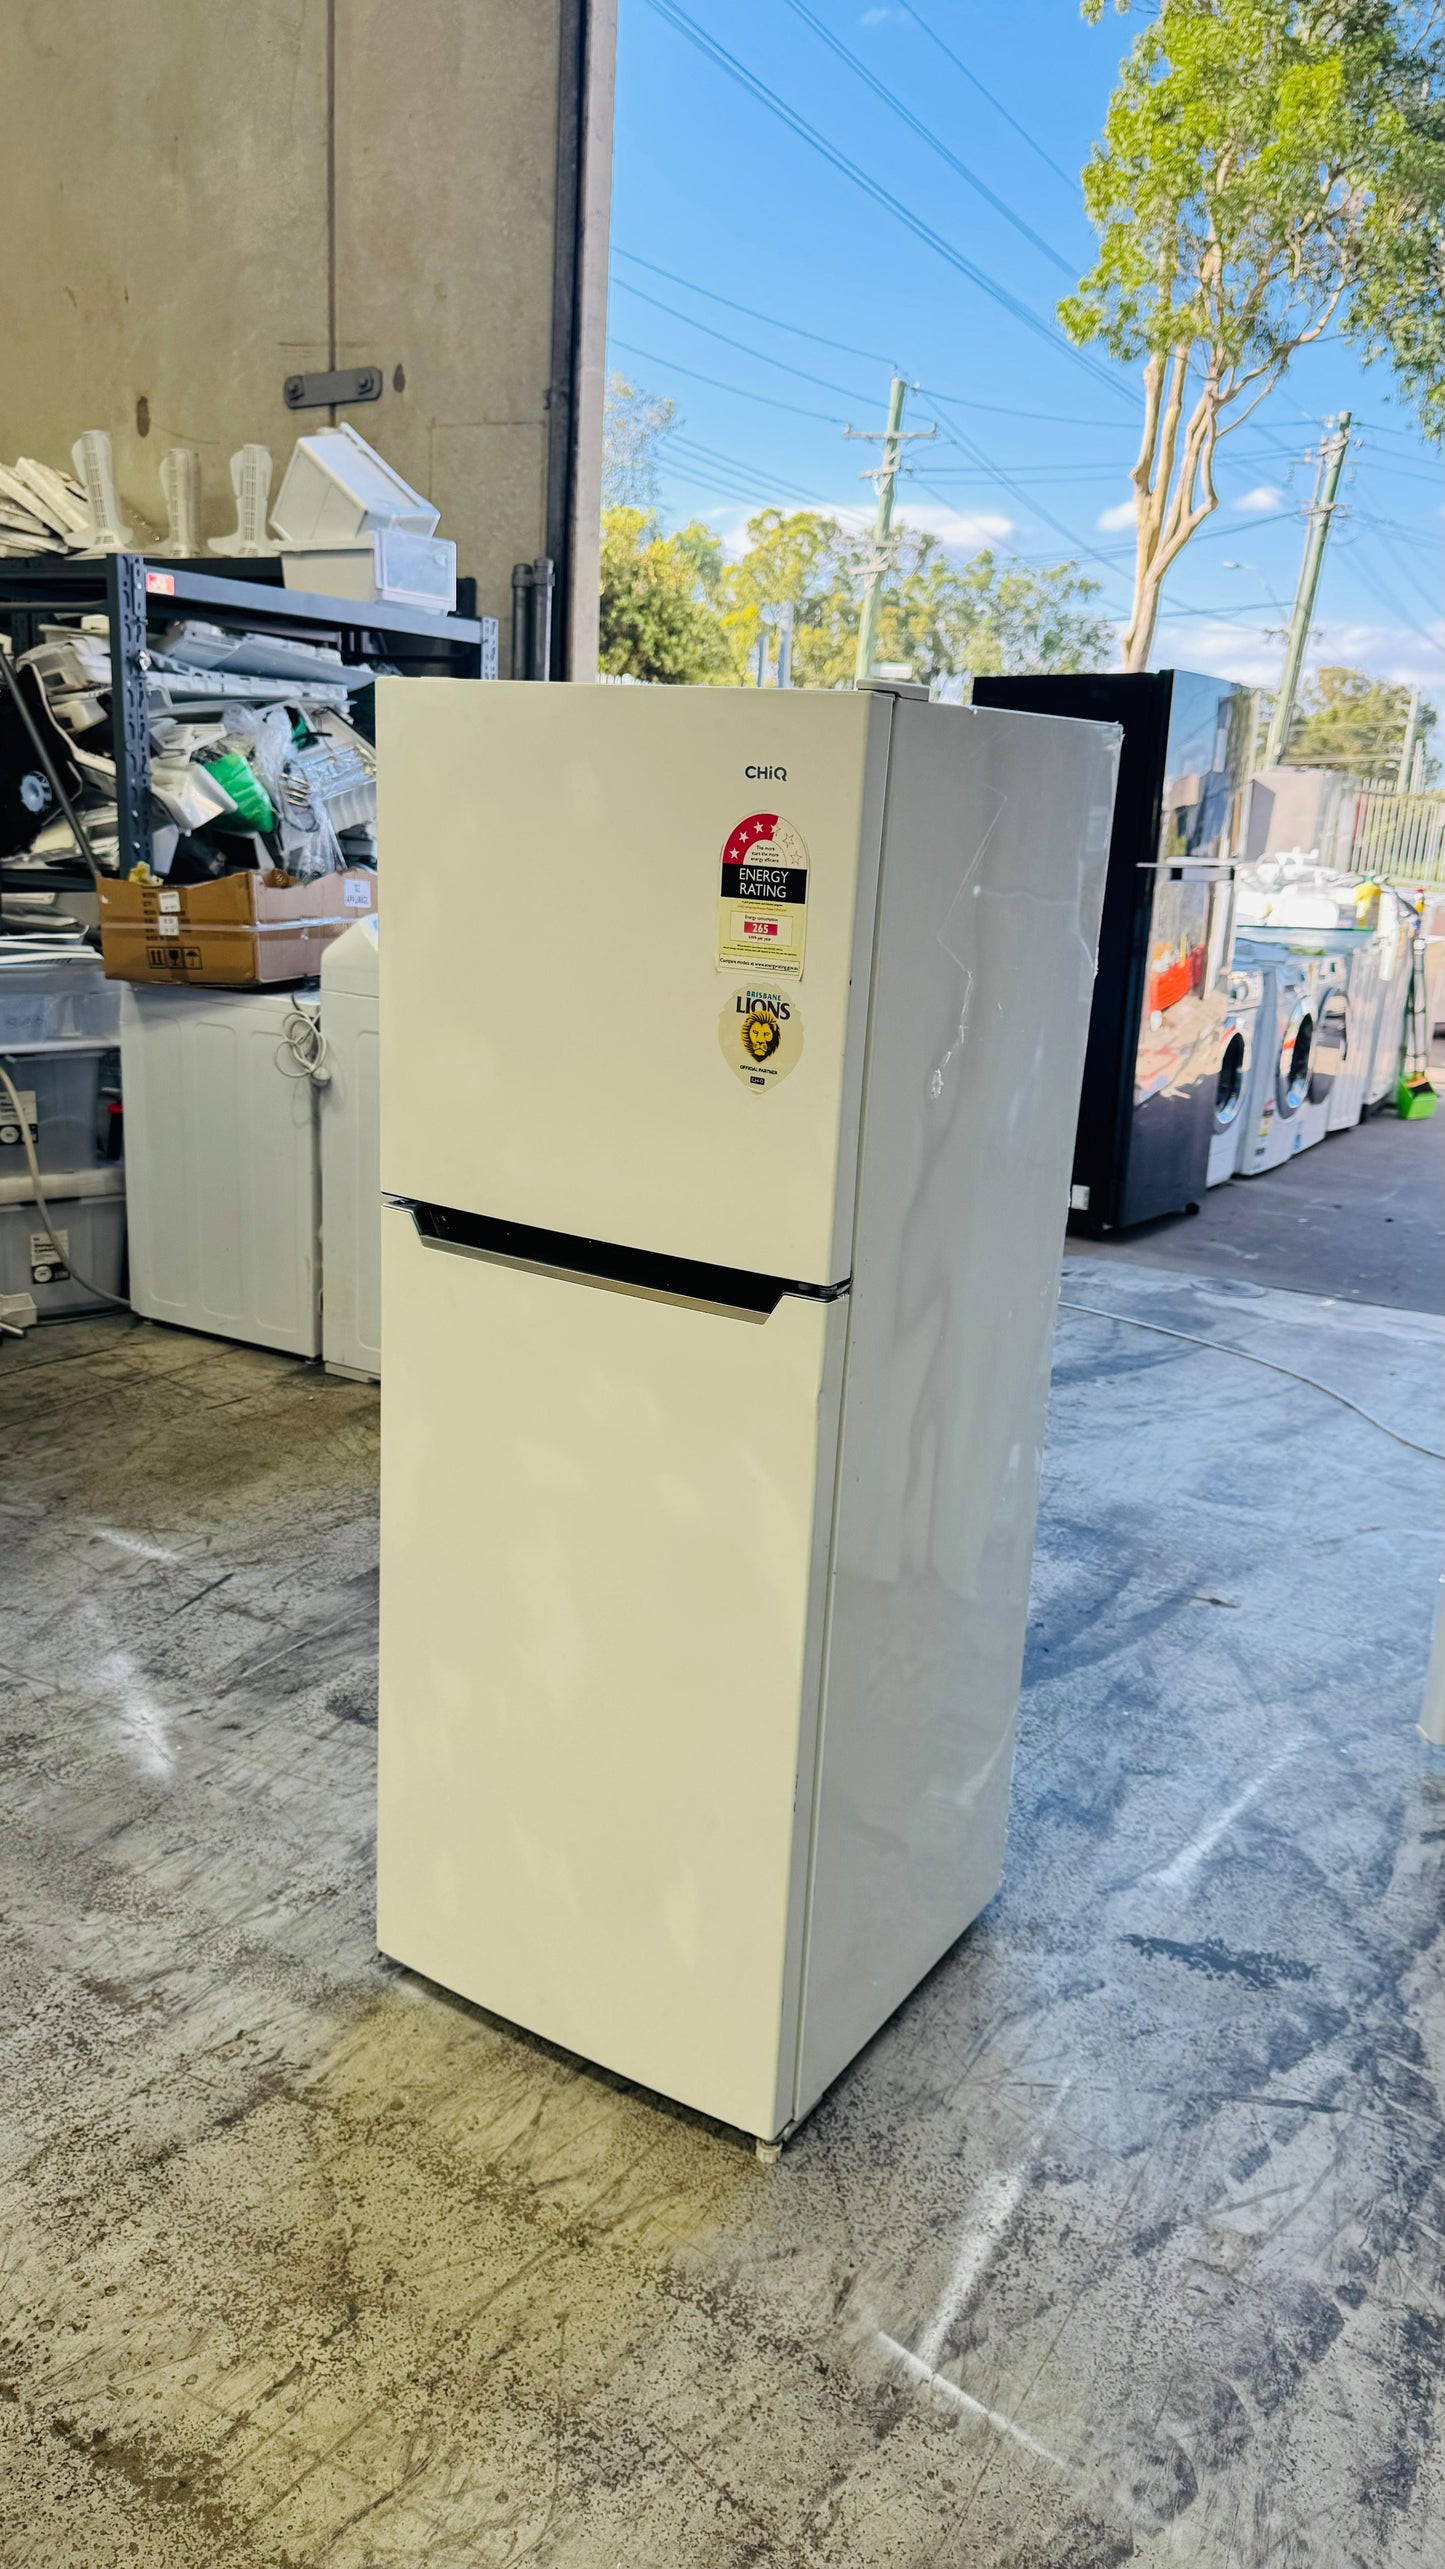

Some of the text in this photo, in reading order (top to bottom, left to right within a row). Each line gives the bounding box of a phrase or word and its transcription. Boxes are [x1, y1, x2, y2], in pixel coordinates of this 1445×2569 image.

[745, 765, 787, 781] CHiQ
[739, 867, 789, 884] ENERGY
[739, 882, 787, 898] RATING
[752, 923, 769, 934] 265
[746, 990, 781, 1001] BRISBANE
[736, 996, 790, 1020] LIONS
[740, 1064, 778, 1075] OFFICIAL PARTNER
